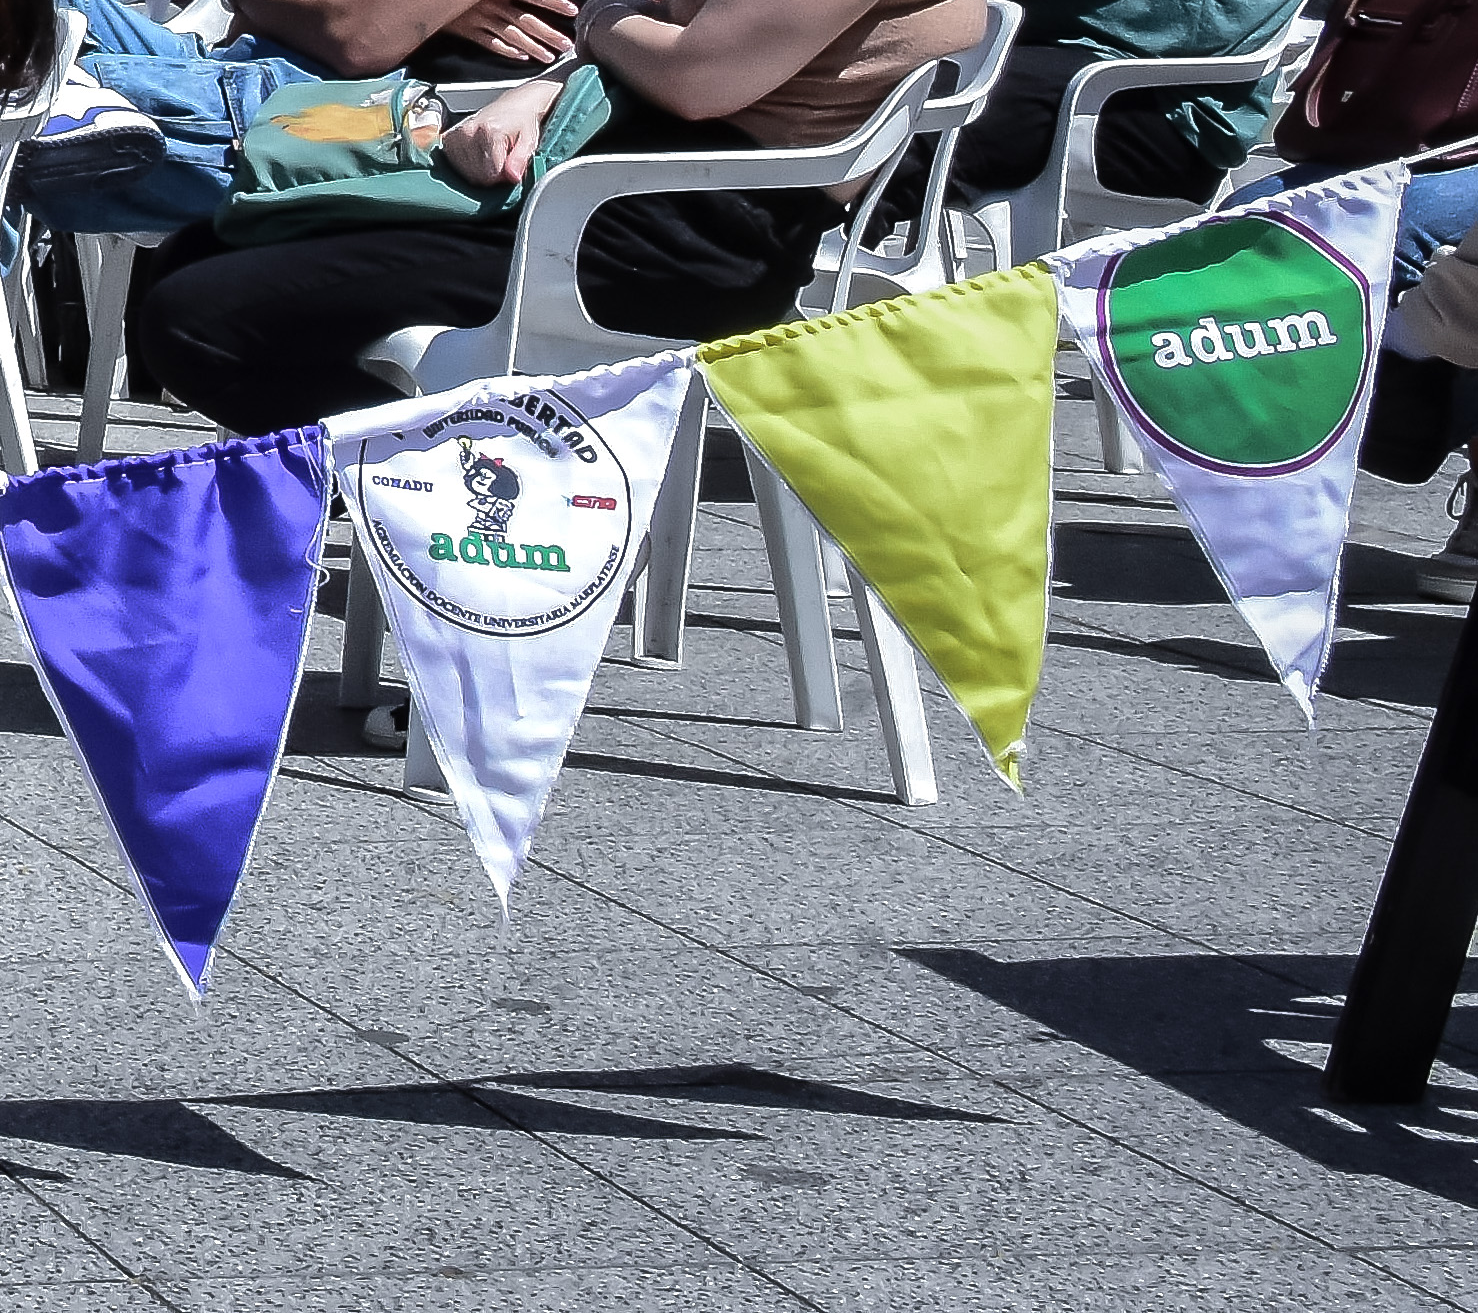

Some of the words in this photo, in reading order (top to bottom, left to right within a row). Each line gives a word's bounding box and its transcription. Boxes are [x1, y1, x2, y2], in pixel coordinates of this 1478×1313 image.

[1150, 309, 1338, 368] adum
[428, 531, 570, 572] adum
[426, 588, 482, 624] DOCENTE
[482, 605, 572, 629] UNIVERSITARIA
[570, 544, 620, 611] MARPLATENSE
